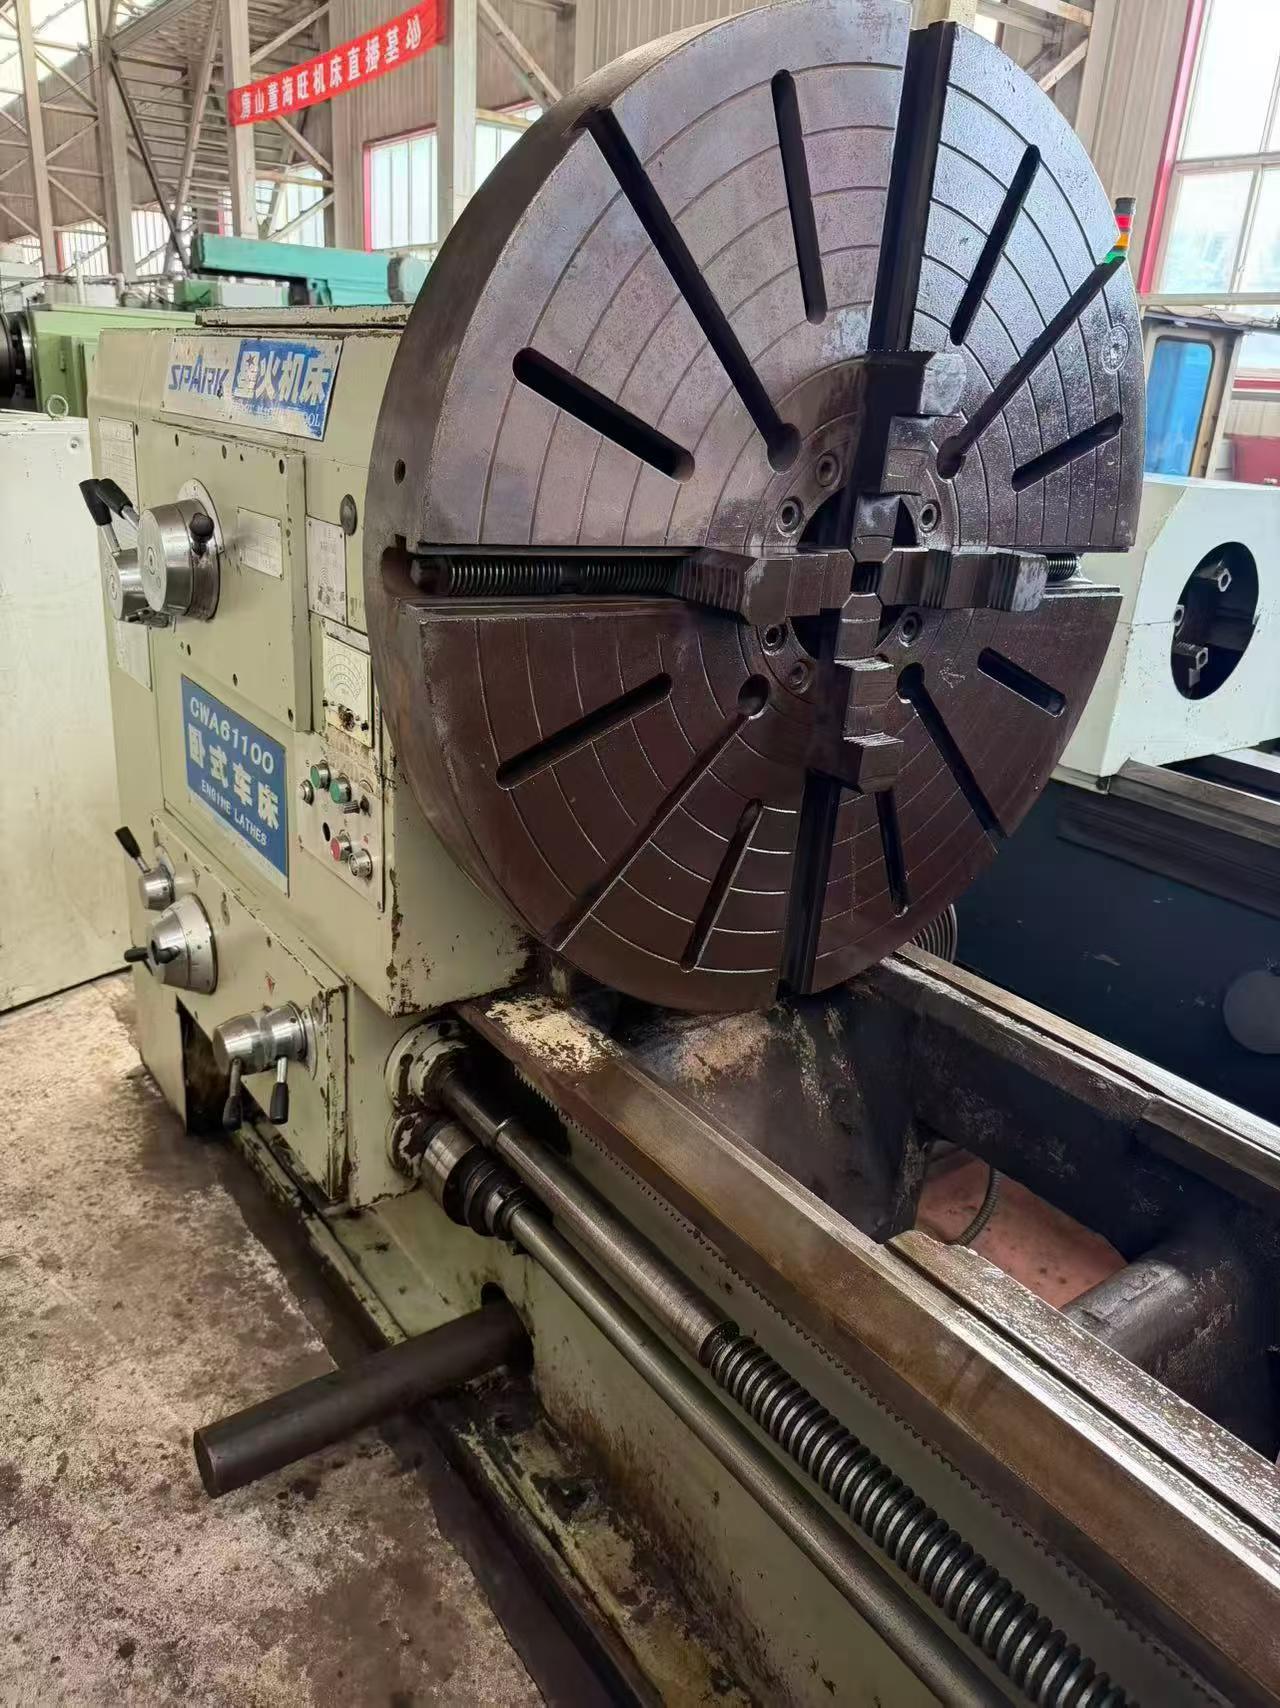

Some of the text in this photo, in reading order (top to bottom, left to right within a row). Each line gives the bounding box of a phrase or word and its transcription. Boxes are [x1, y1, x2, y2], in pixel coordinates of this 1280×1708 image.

[168, 354, 229, 398] SPARK
[232, 351, 332, 405] 星火机床
[190, 697, 274, 774] CWA61100
[188, 723, 279, 830] 卧式车床
[201, 779, 267, 846] ENGINE LATHES
